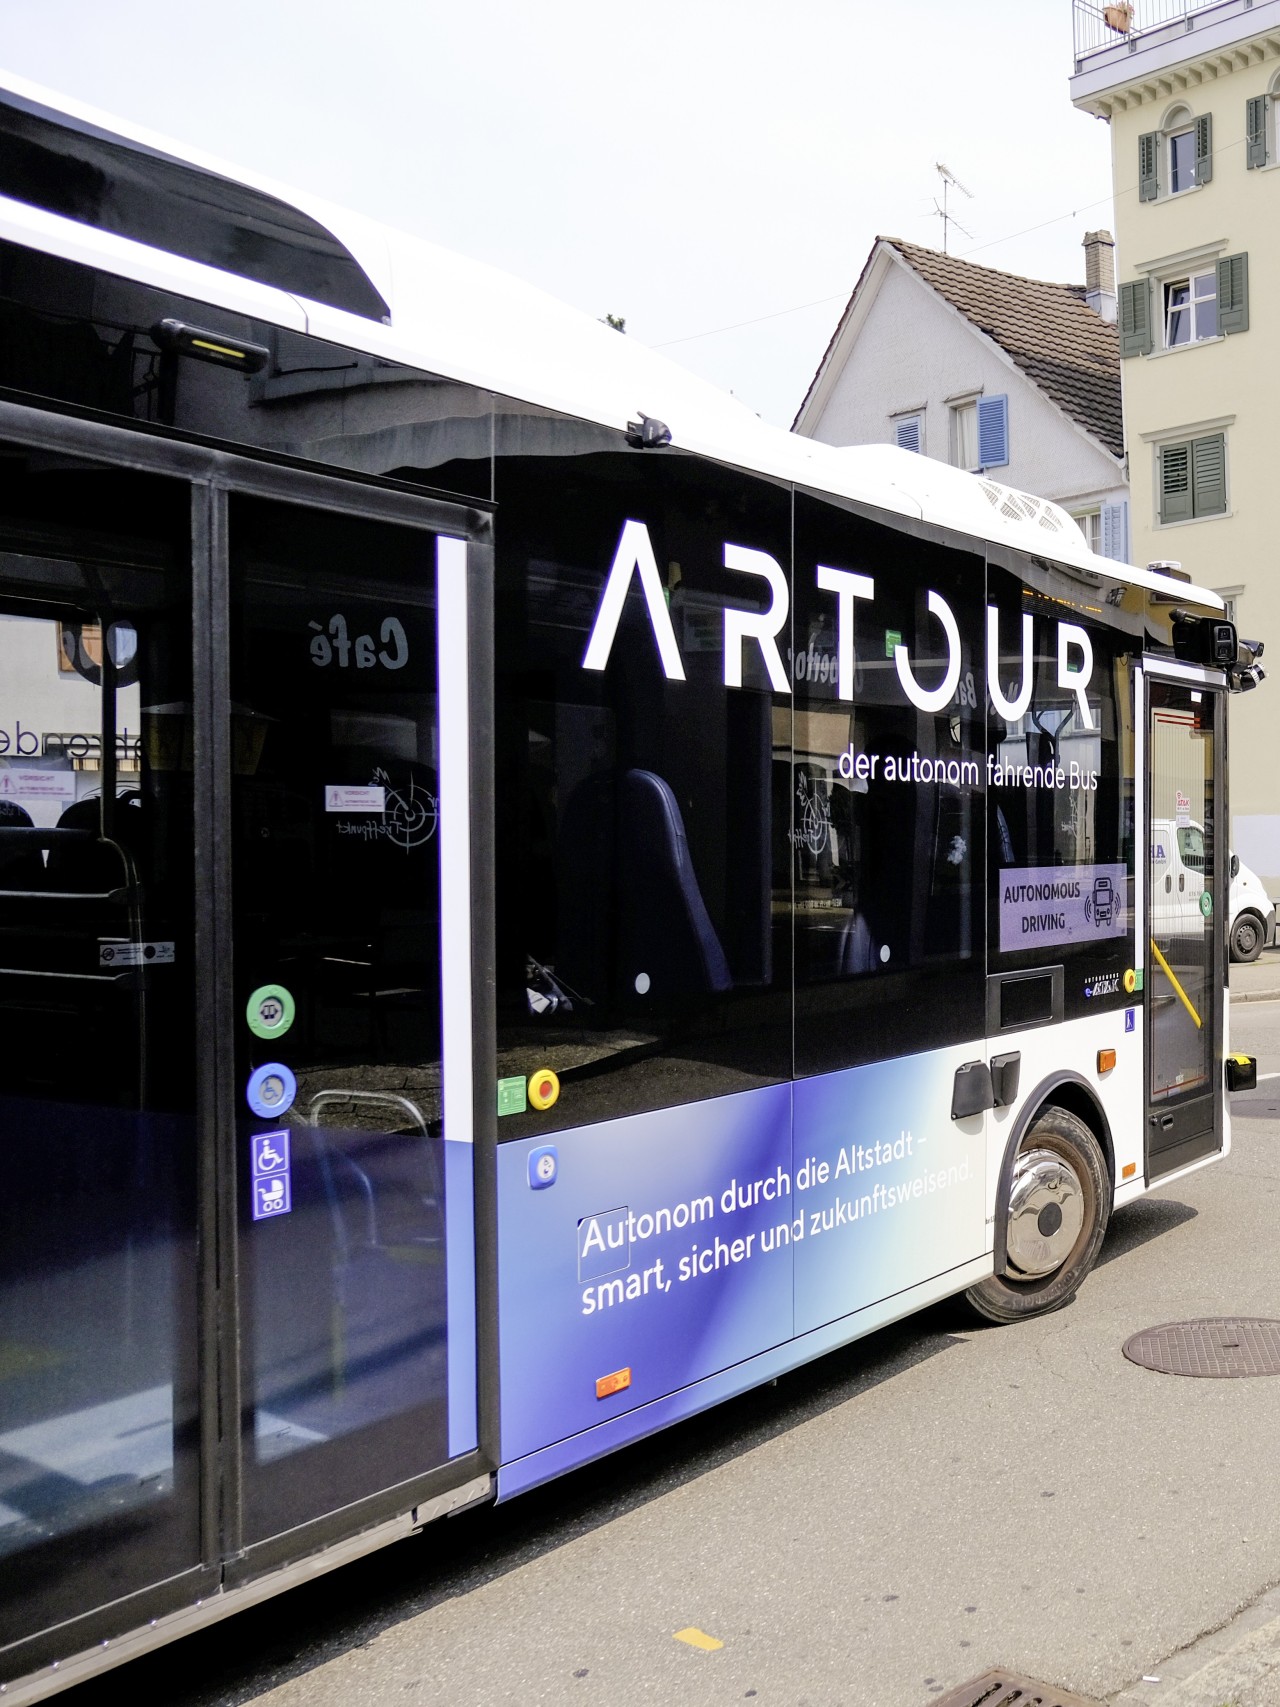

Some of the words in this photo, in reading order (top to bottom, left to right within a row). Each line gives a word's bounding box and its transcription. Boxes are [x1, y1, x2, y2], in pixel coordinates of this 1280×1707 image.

[839, 743, 879, 780] der
[884, 751, 979, 786] autonom
[986, 755, 1066, 789] fahrende
[1070, 761, 1098, 791] Bus
[1004, 881, 1081, 904] AUTONOMOUS
[1021, 912, 1066, 934] DRIVING
[581, 1194, 714, 1258] Autonom
[720, 1165, 791, 1214] durch
[797, 1157, 830, 1191] die
[834, 1131, 914, 1179] Altstadt
[581, 1259, 673, 1315] smart,
[678, 1232, 755, 1283] sicher
[760, 1210, 805, 1253] und
[810, 1156, 974, 1236] zukunftsweisend.
